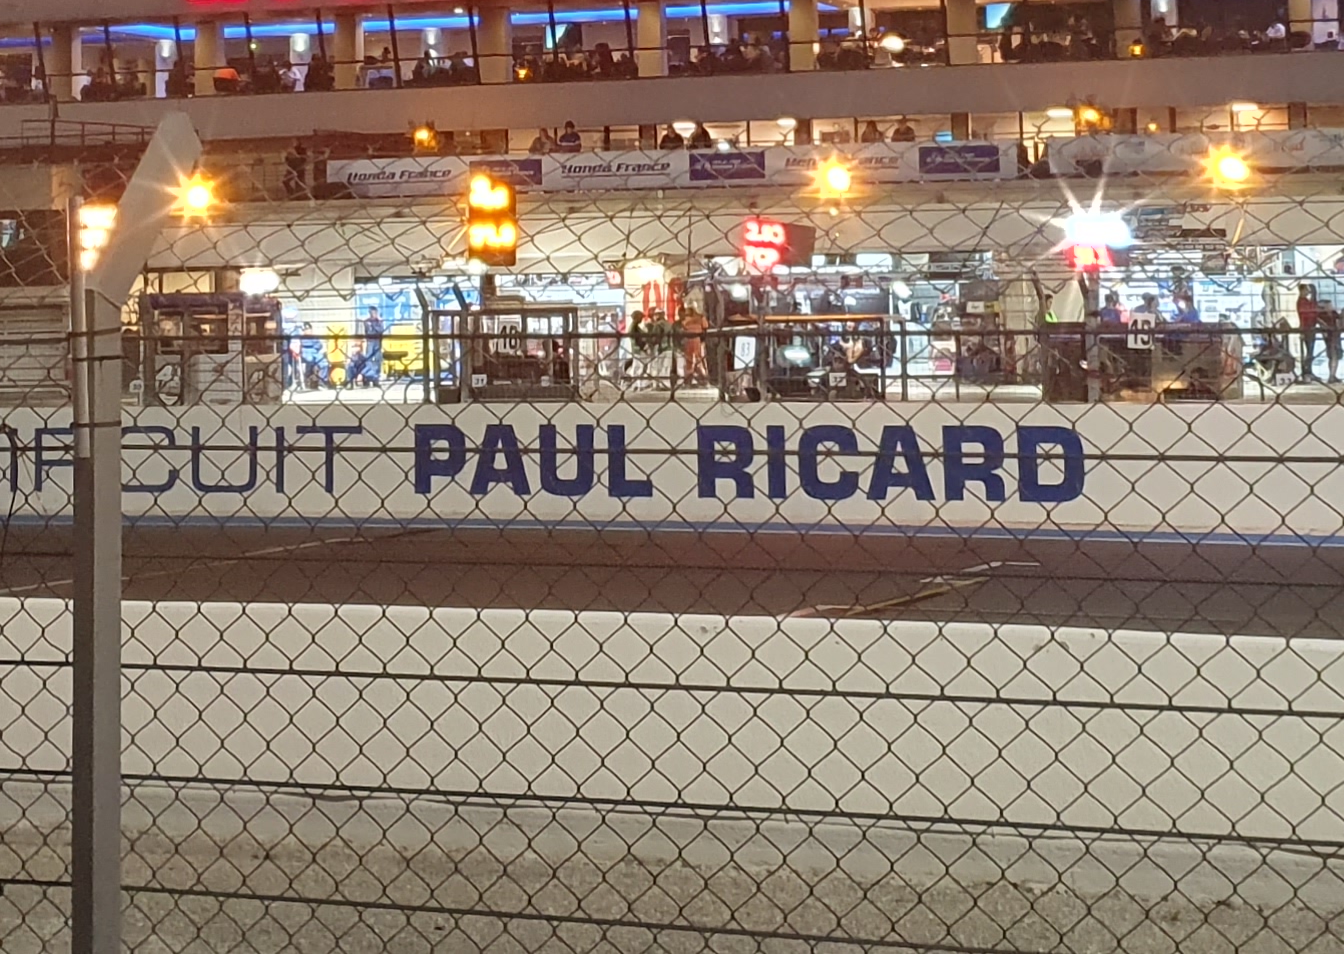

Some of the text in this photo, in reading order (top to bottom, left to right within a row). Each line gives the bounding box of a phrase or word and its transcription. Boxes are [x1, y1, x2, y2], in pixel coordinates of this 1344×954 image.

[399, 168, 452, 180] France
[561, 161, 671, 175] Honda France
[1131, 318, 1153, 345] 19
[414, 423, 654, 497] PAUL
[696, 424, 1086, 503] RICARD
